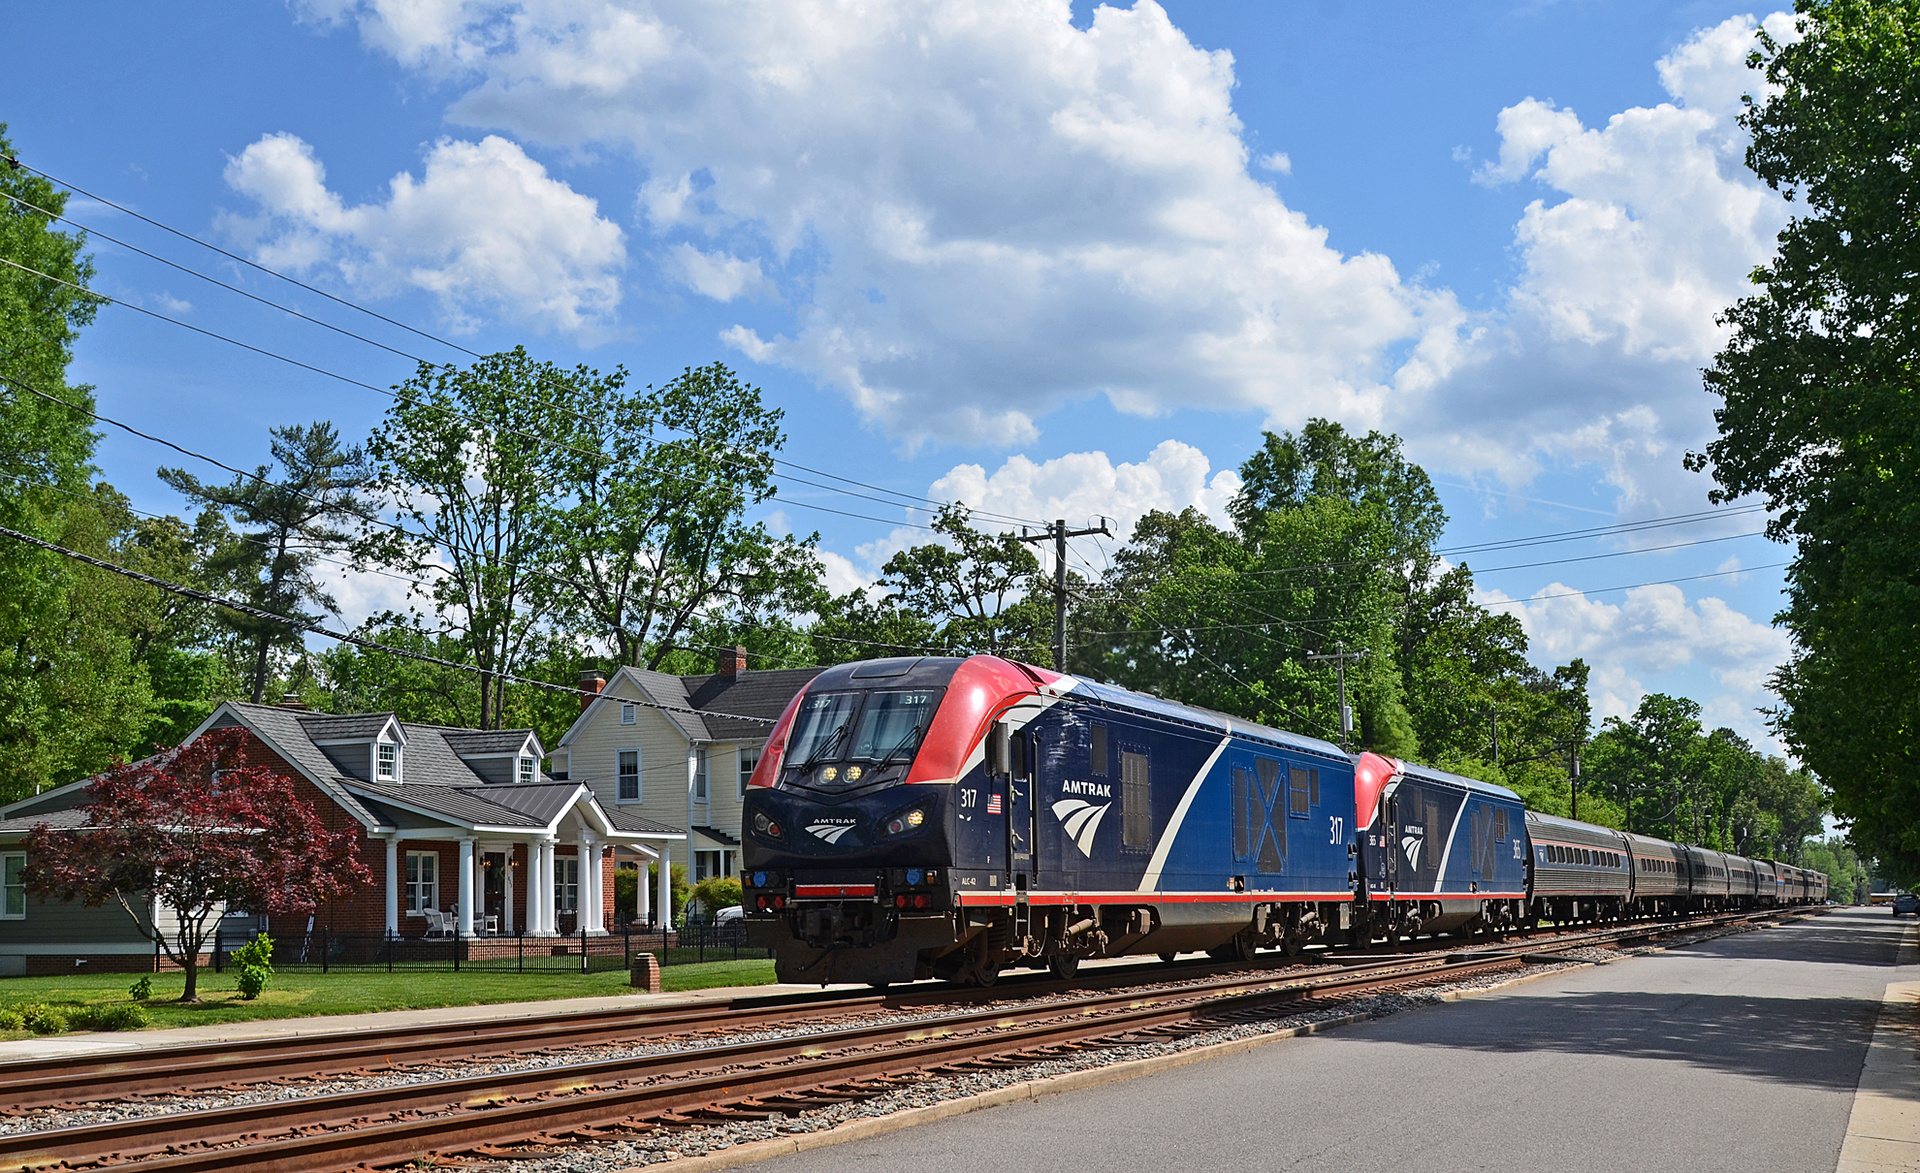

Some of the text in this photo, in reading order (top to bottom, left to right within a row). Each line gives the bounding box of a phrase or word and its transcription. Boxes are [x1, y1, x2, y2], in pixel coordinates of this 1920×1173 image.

[811, 699, 831, 709] 317
[904, 695, 927, 705] 317
[1062, 779, 1112, 798] AMTRAK
[960, 788, 977, 808] 317
[1329, 815, 1343, 845] 317
[1404, 824, 1424, 835] AMTRAK
